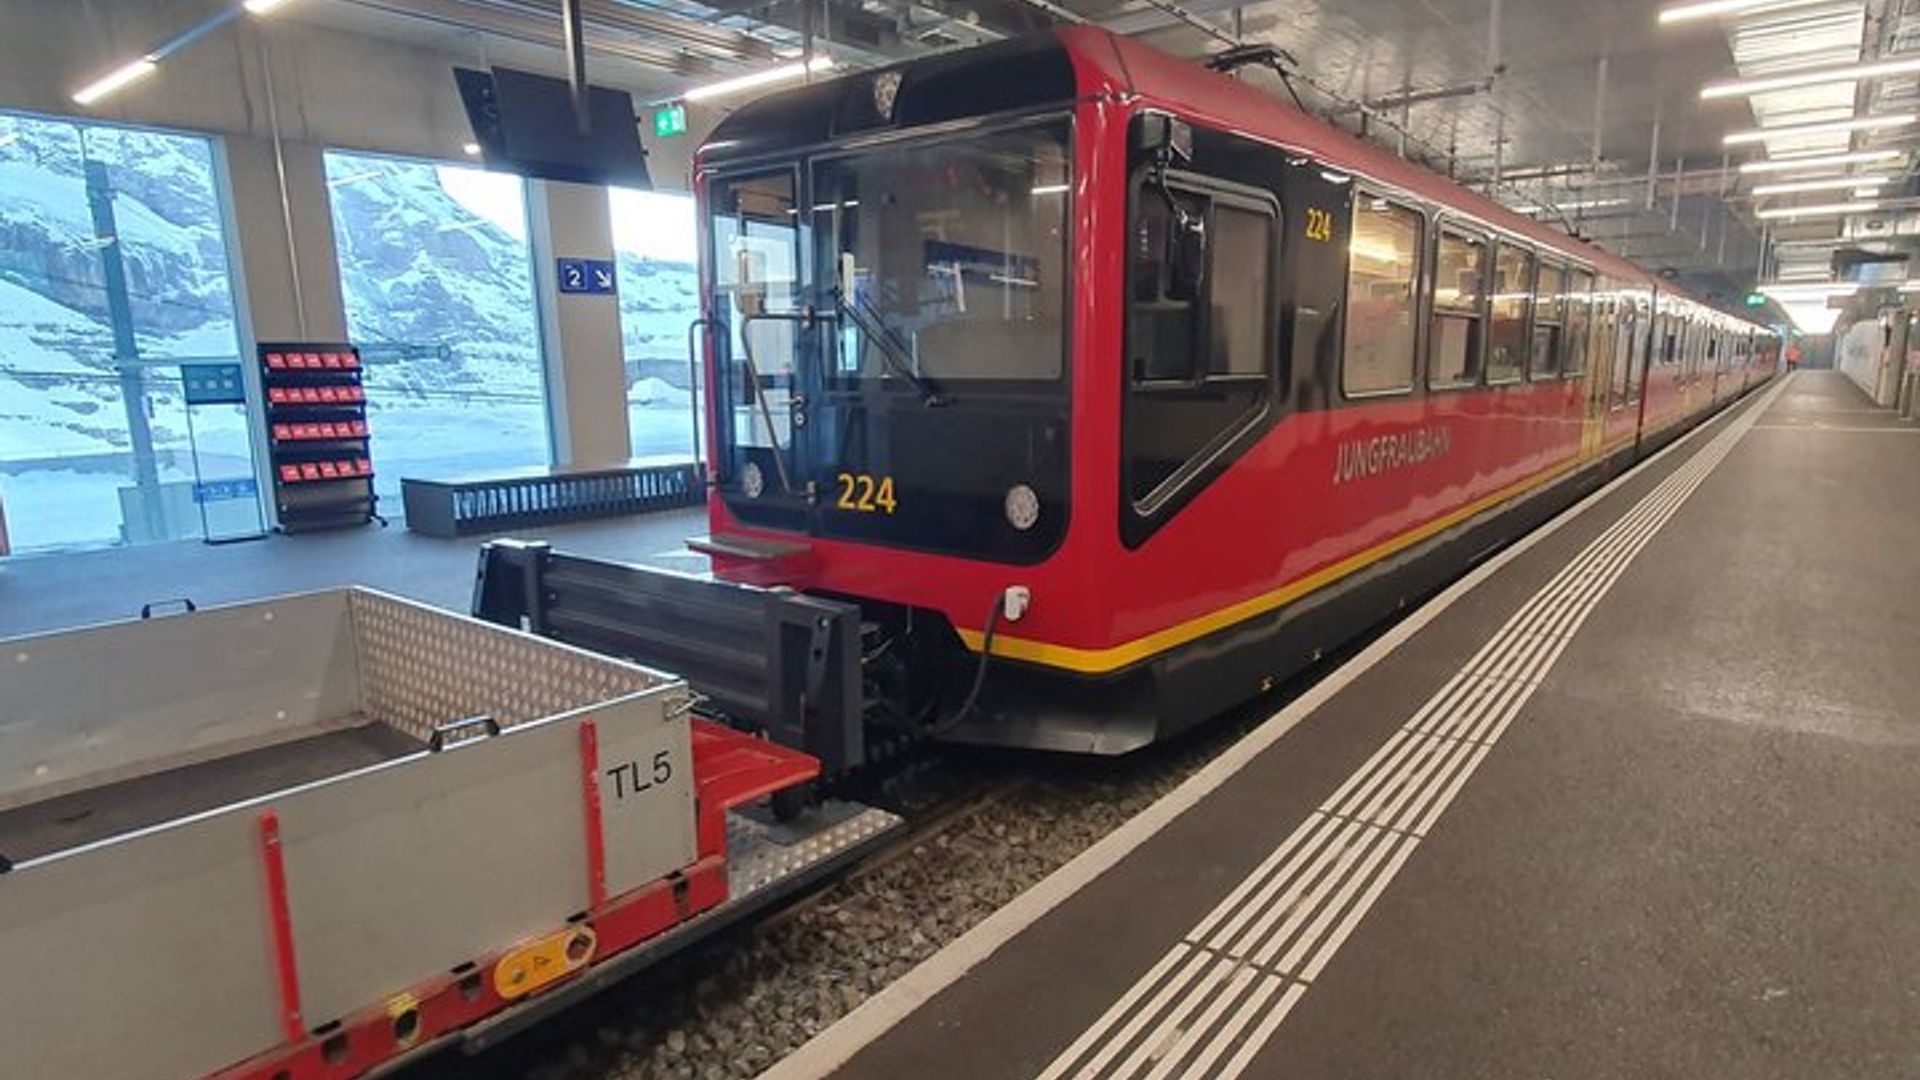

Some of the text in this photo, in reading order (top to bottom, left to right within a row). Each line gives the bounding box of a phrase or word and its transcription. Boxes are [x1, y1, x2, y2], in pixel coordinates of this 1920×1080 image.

[1306, 208, 1330, 242] 224
[568, 269, 581, 287] 2
[1332, 426, 1452, 486] JUNGFRAUBAHN
[837, 472, 897, 514] 224
[606, 750, 671, 799] TL5
